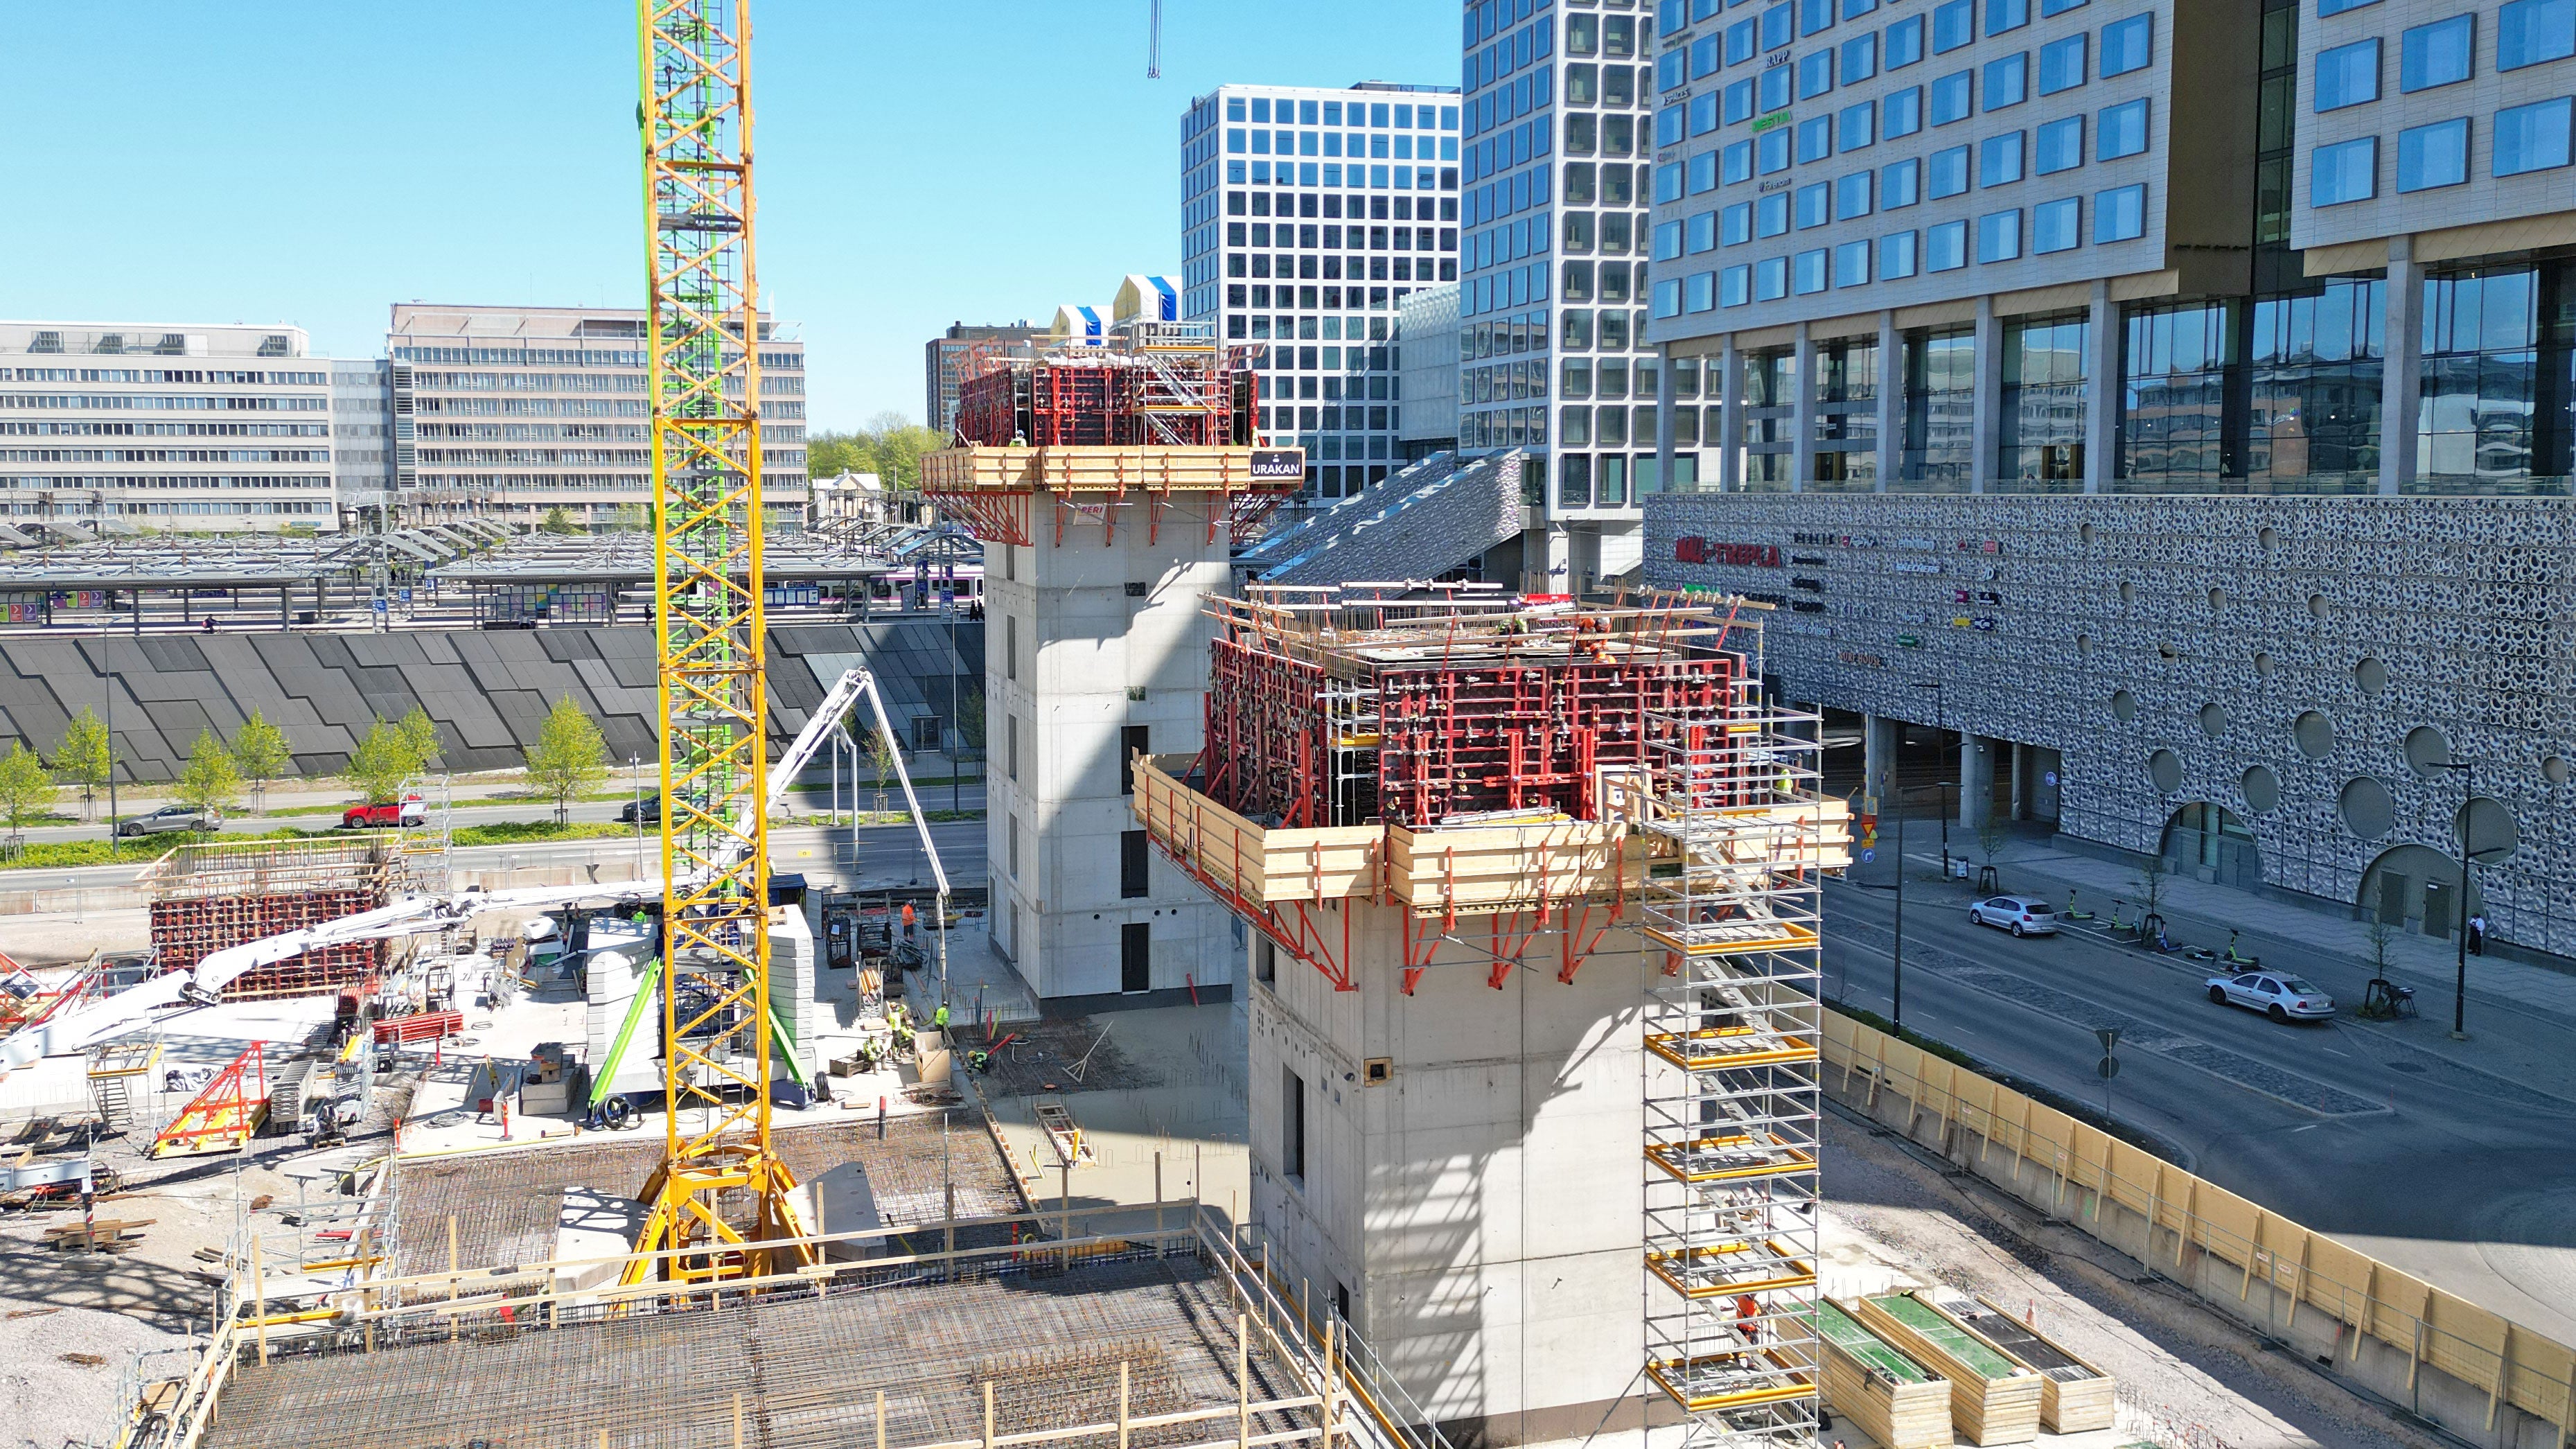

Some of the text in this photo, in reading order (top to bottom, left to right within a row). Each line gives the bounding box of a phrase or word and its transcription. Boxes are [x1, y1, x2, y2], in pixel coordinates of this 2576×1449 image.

[1252, 464, 1300, 475] URAKAN
[1082, 506, 1103, 514] PERI
[1713, 543, 1781, 567] TRIPLA
[1895, 563, 1941, 573] SKECHERS
[1840, 603, 1873, 618] KICKS
[1902, 611, 1925, 622] Normal
